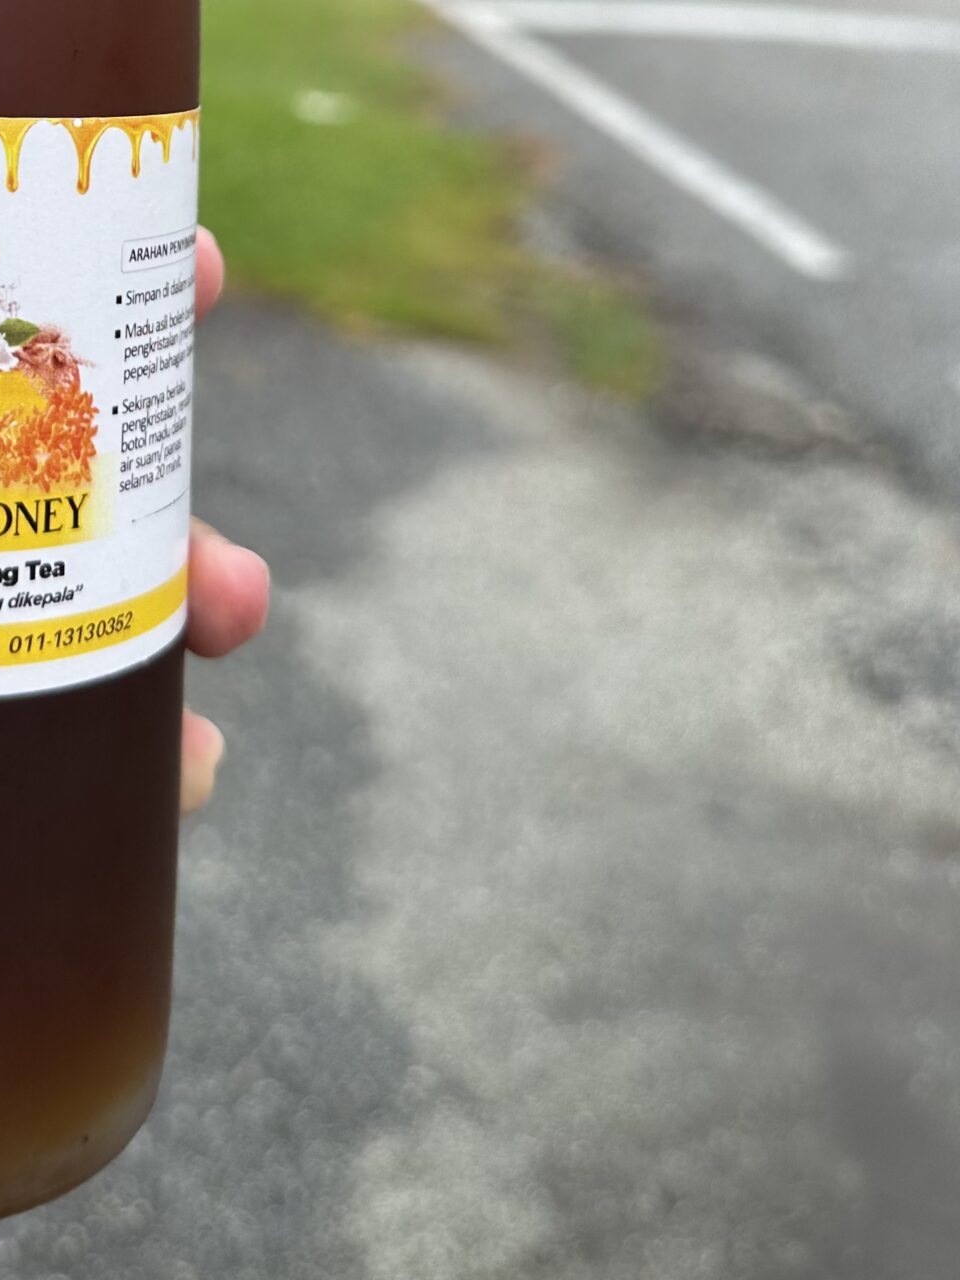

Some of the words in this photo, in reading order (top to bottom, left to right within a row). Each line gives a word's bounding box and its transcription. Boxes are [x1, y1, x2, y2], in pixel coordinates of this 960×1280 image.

[129, 243, 168, 263] ARAHAN
[126, 287, 161, 306] Simpan
[162, 280, 170, 298] di
[125, 318, 155, 339] Madu
[155, 313, 168, 332] asli
[124, 328, 178, 362] pengkristalan
[123, 357, 159, 384] pepejal
[122, 391, 165, 414] Sekiranya
[121, 431, 147, 453] botol
[148, 424, 170, 445] madu
[119, 470, 154, 492] selama
[155, 463, 165, 480] 20
[120, 456, 134, 473] air
[25, 559, 66, 581] Tea
[8, 584, 84, 609] dikepala”
[9, 610, 133, 654] 011-13130352
